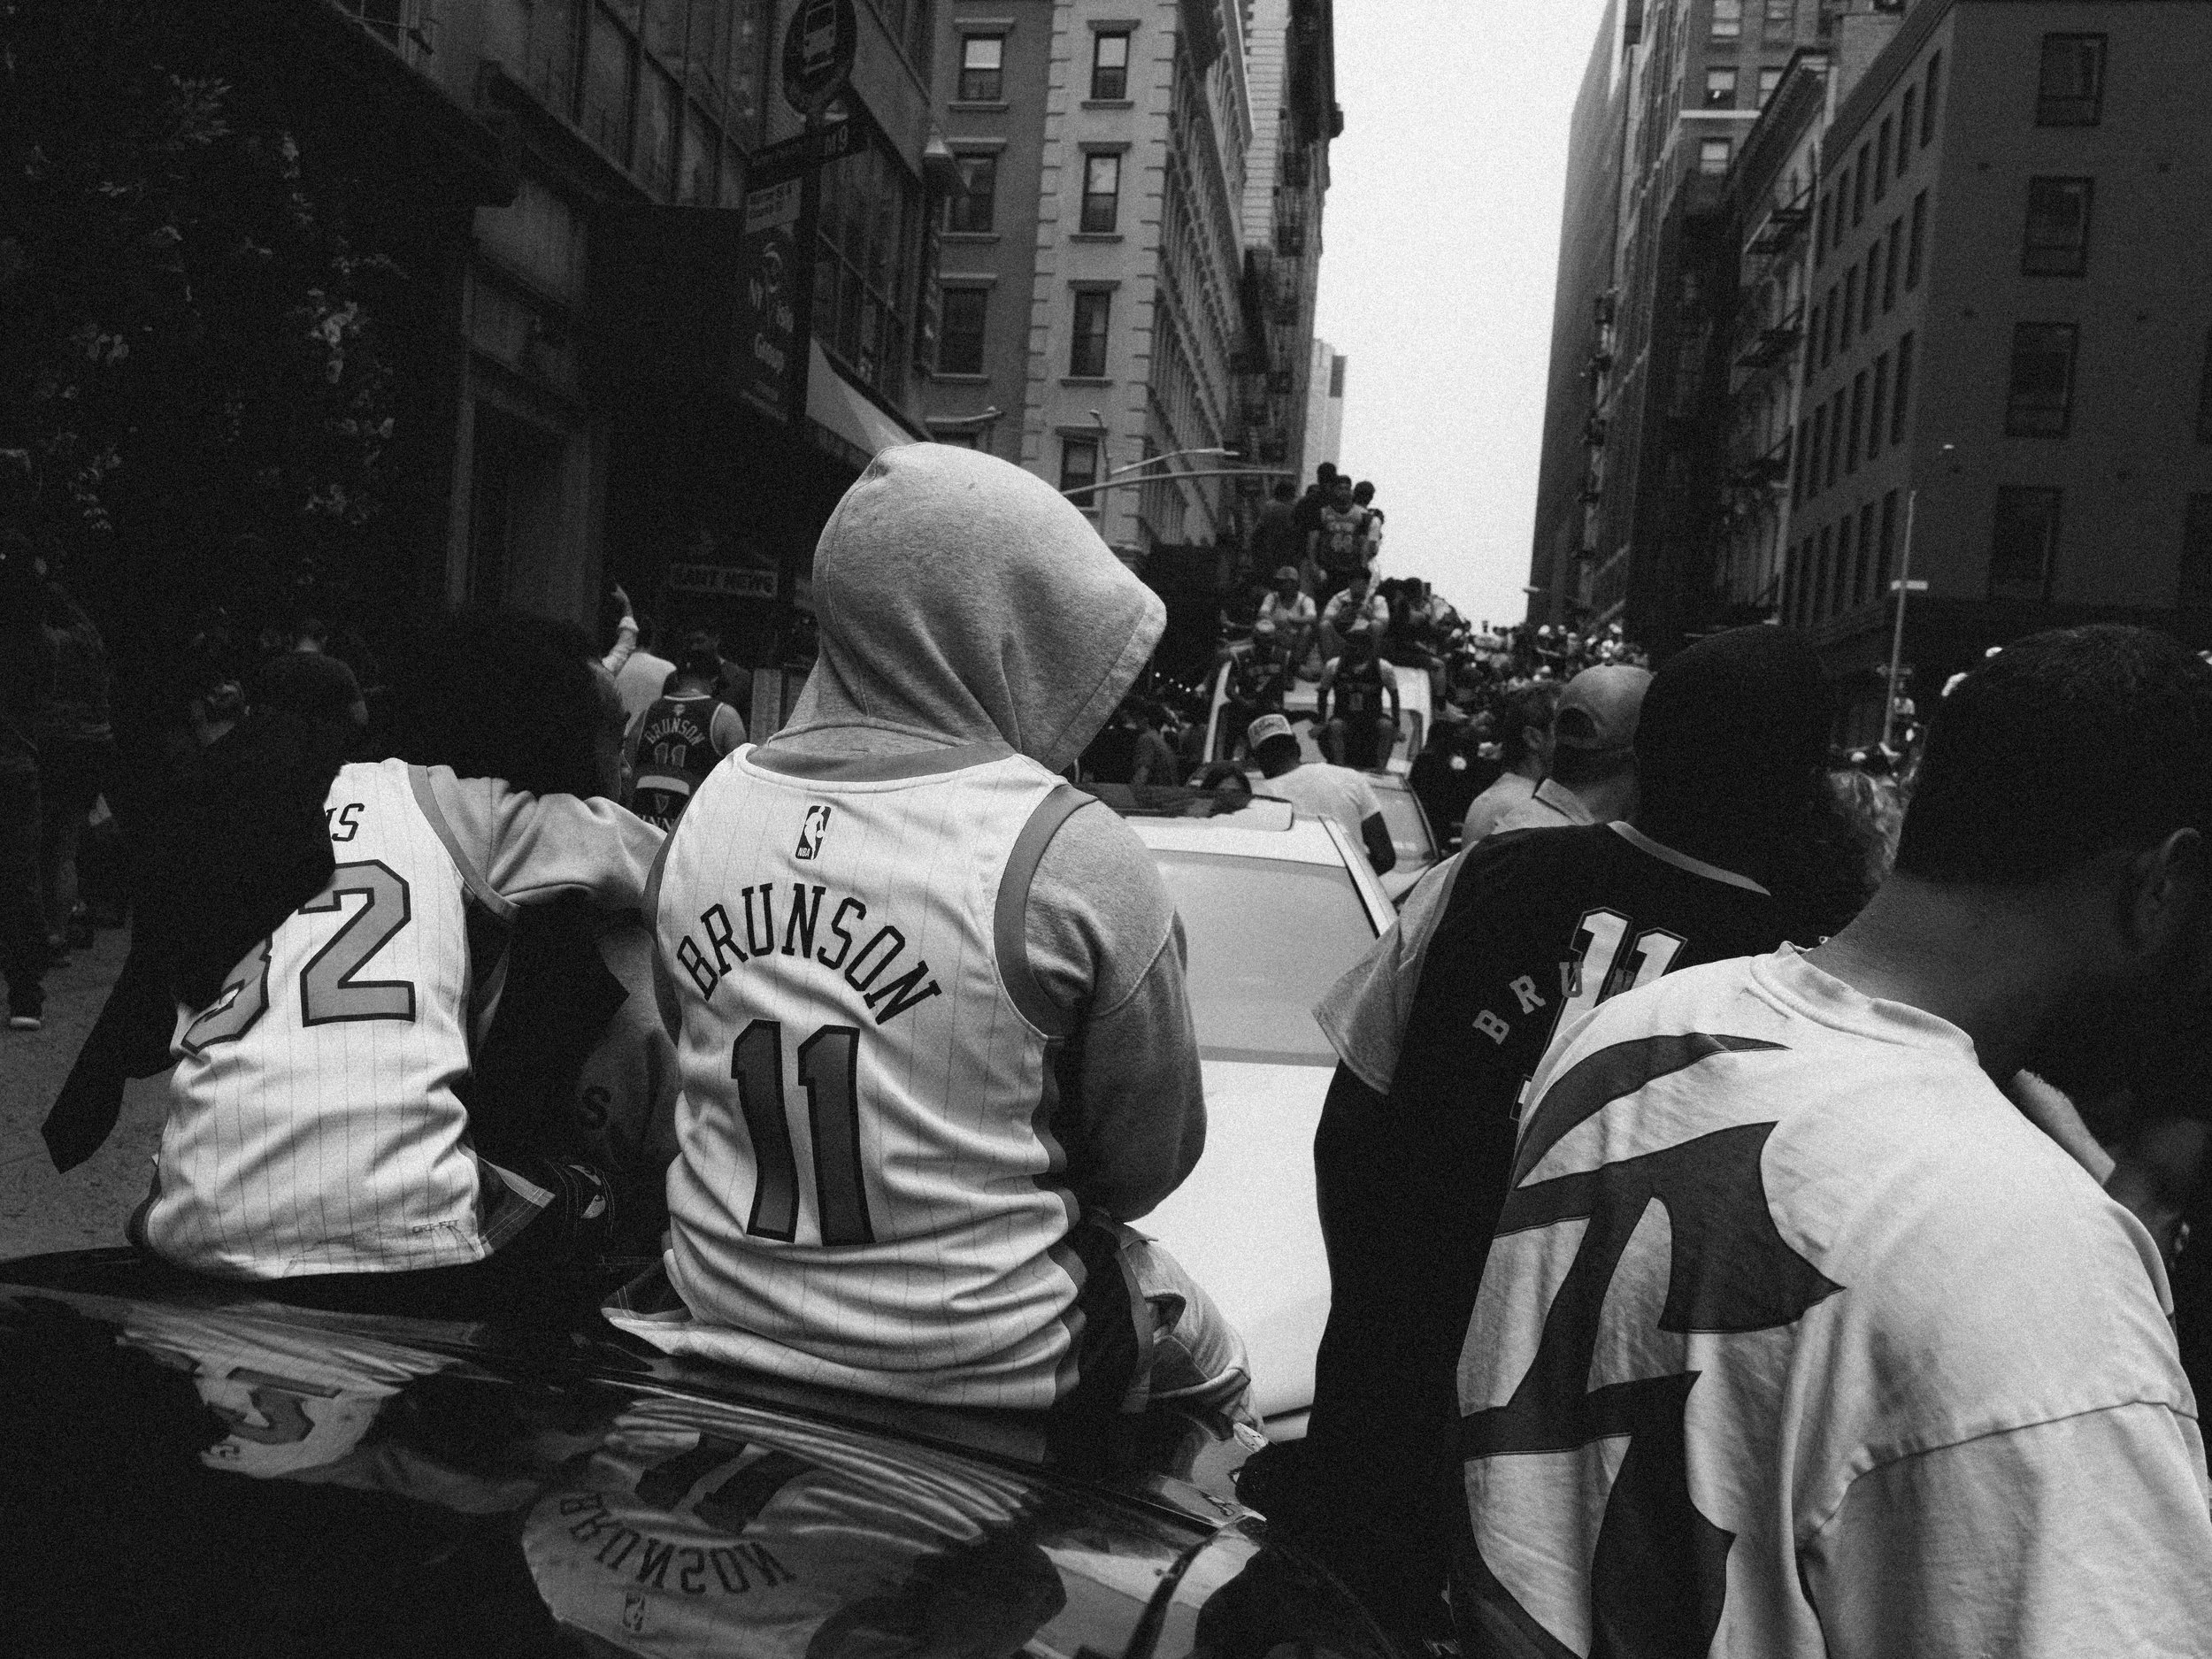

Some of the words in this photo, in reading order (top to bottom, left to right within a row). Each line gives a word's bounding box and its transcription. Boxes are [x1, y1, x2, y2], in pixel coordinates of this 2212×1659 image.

[824, 124, 849, 157] M9
[644, 718, 706, 746] BRUNSON
[654, 741, 687, 768] 11
[797, 847, 811, 857] NBA
[677, 882, 942, 1025] BRUNSON
[731, 1018, 878, 1248] 11
